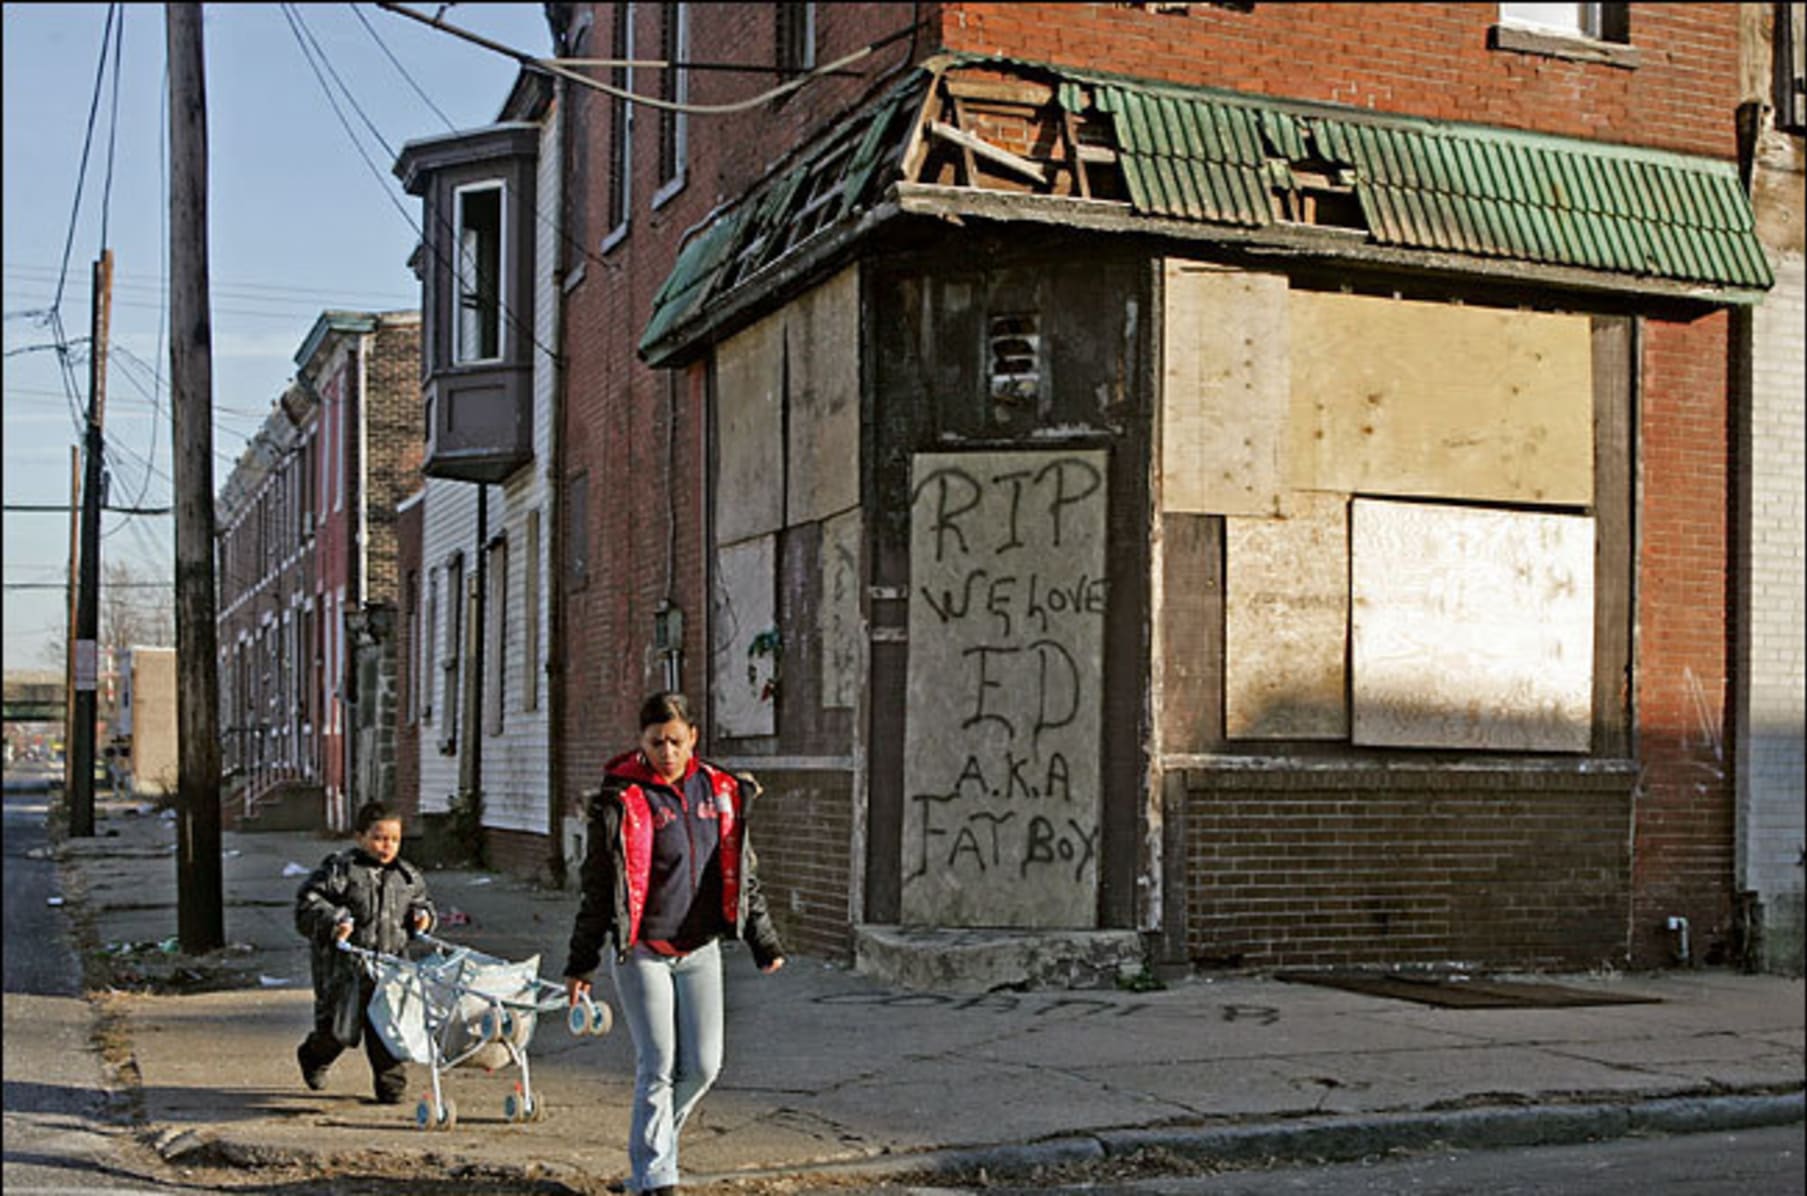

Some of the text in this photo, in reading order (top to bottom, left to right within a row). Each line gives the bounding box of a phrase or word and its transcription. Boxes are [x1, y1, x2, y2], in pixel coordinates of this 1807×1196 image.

[911, 457, 1102, 562] RIP
[920, 568, 1108, 637] WE LOVE
[961, 638, 1080, 741] ED
[954, 751, 1072, 802] A.K.A
[904, 793, 1017, 887] FAT
